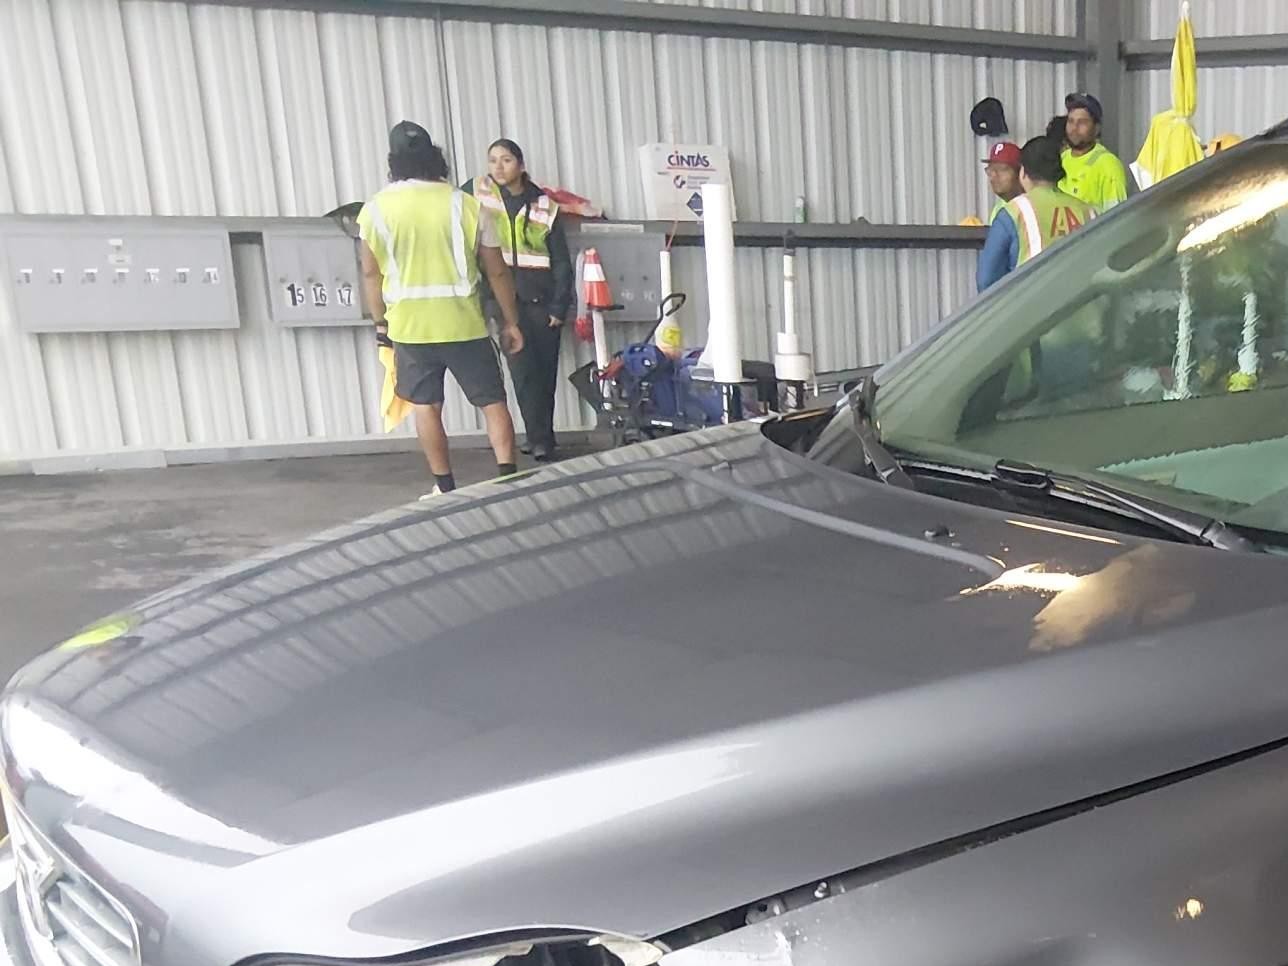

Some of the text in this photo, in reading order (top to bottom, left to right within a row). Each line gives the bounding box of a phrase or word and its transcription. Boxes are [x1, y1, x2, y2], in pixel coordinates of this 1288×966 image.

[995, 143, 1004, 155] P
[667, 151, 710, 168] CINTAS
[287, 283, 352, 306] 15 16 17
